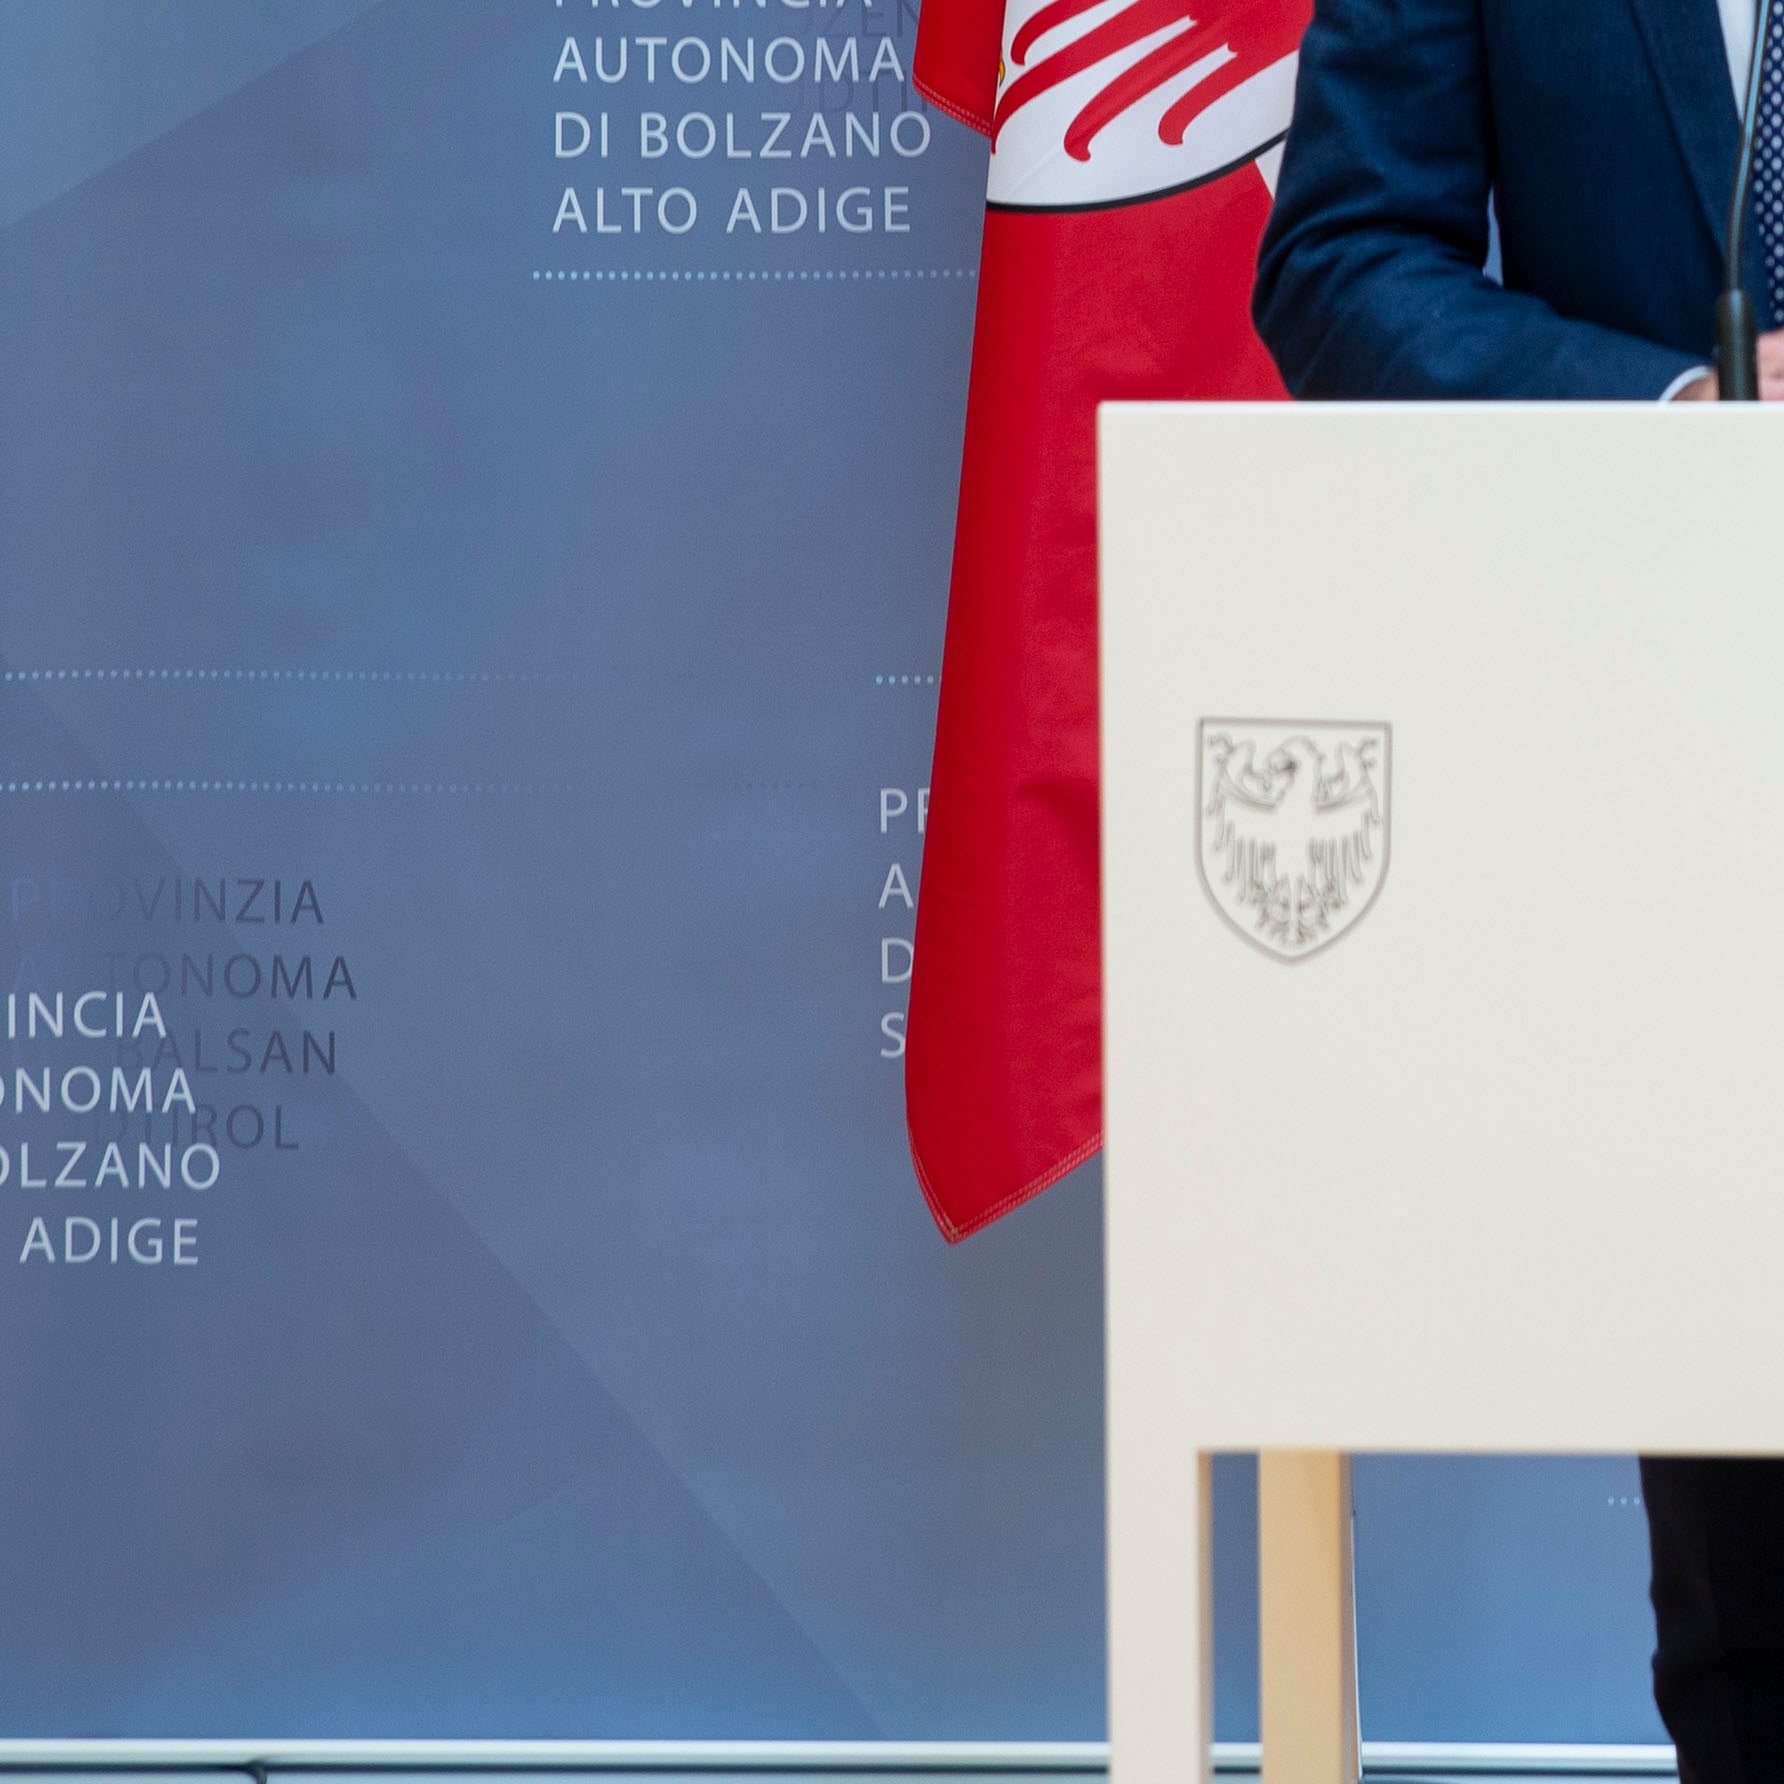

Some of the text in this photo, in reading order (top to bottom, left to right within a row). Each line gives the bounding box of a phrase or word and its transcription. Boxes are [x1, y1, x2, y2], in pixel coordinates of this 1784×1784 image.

[553, 37, 905, 83] AUTONOMA
[554, 111, 931, 159] DI BOLZANO
[552, 187, 911, 234] ALTO ADIGE
[8, 992, 167, 1038] INCIA
[0, 1066, 196, 1113] NOMA
[19, 1217, 199, 1264] ADIGE
